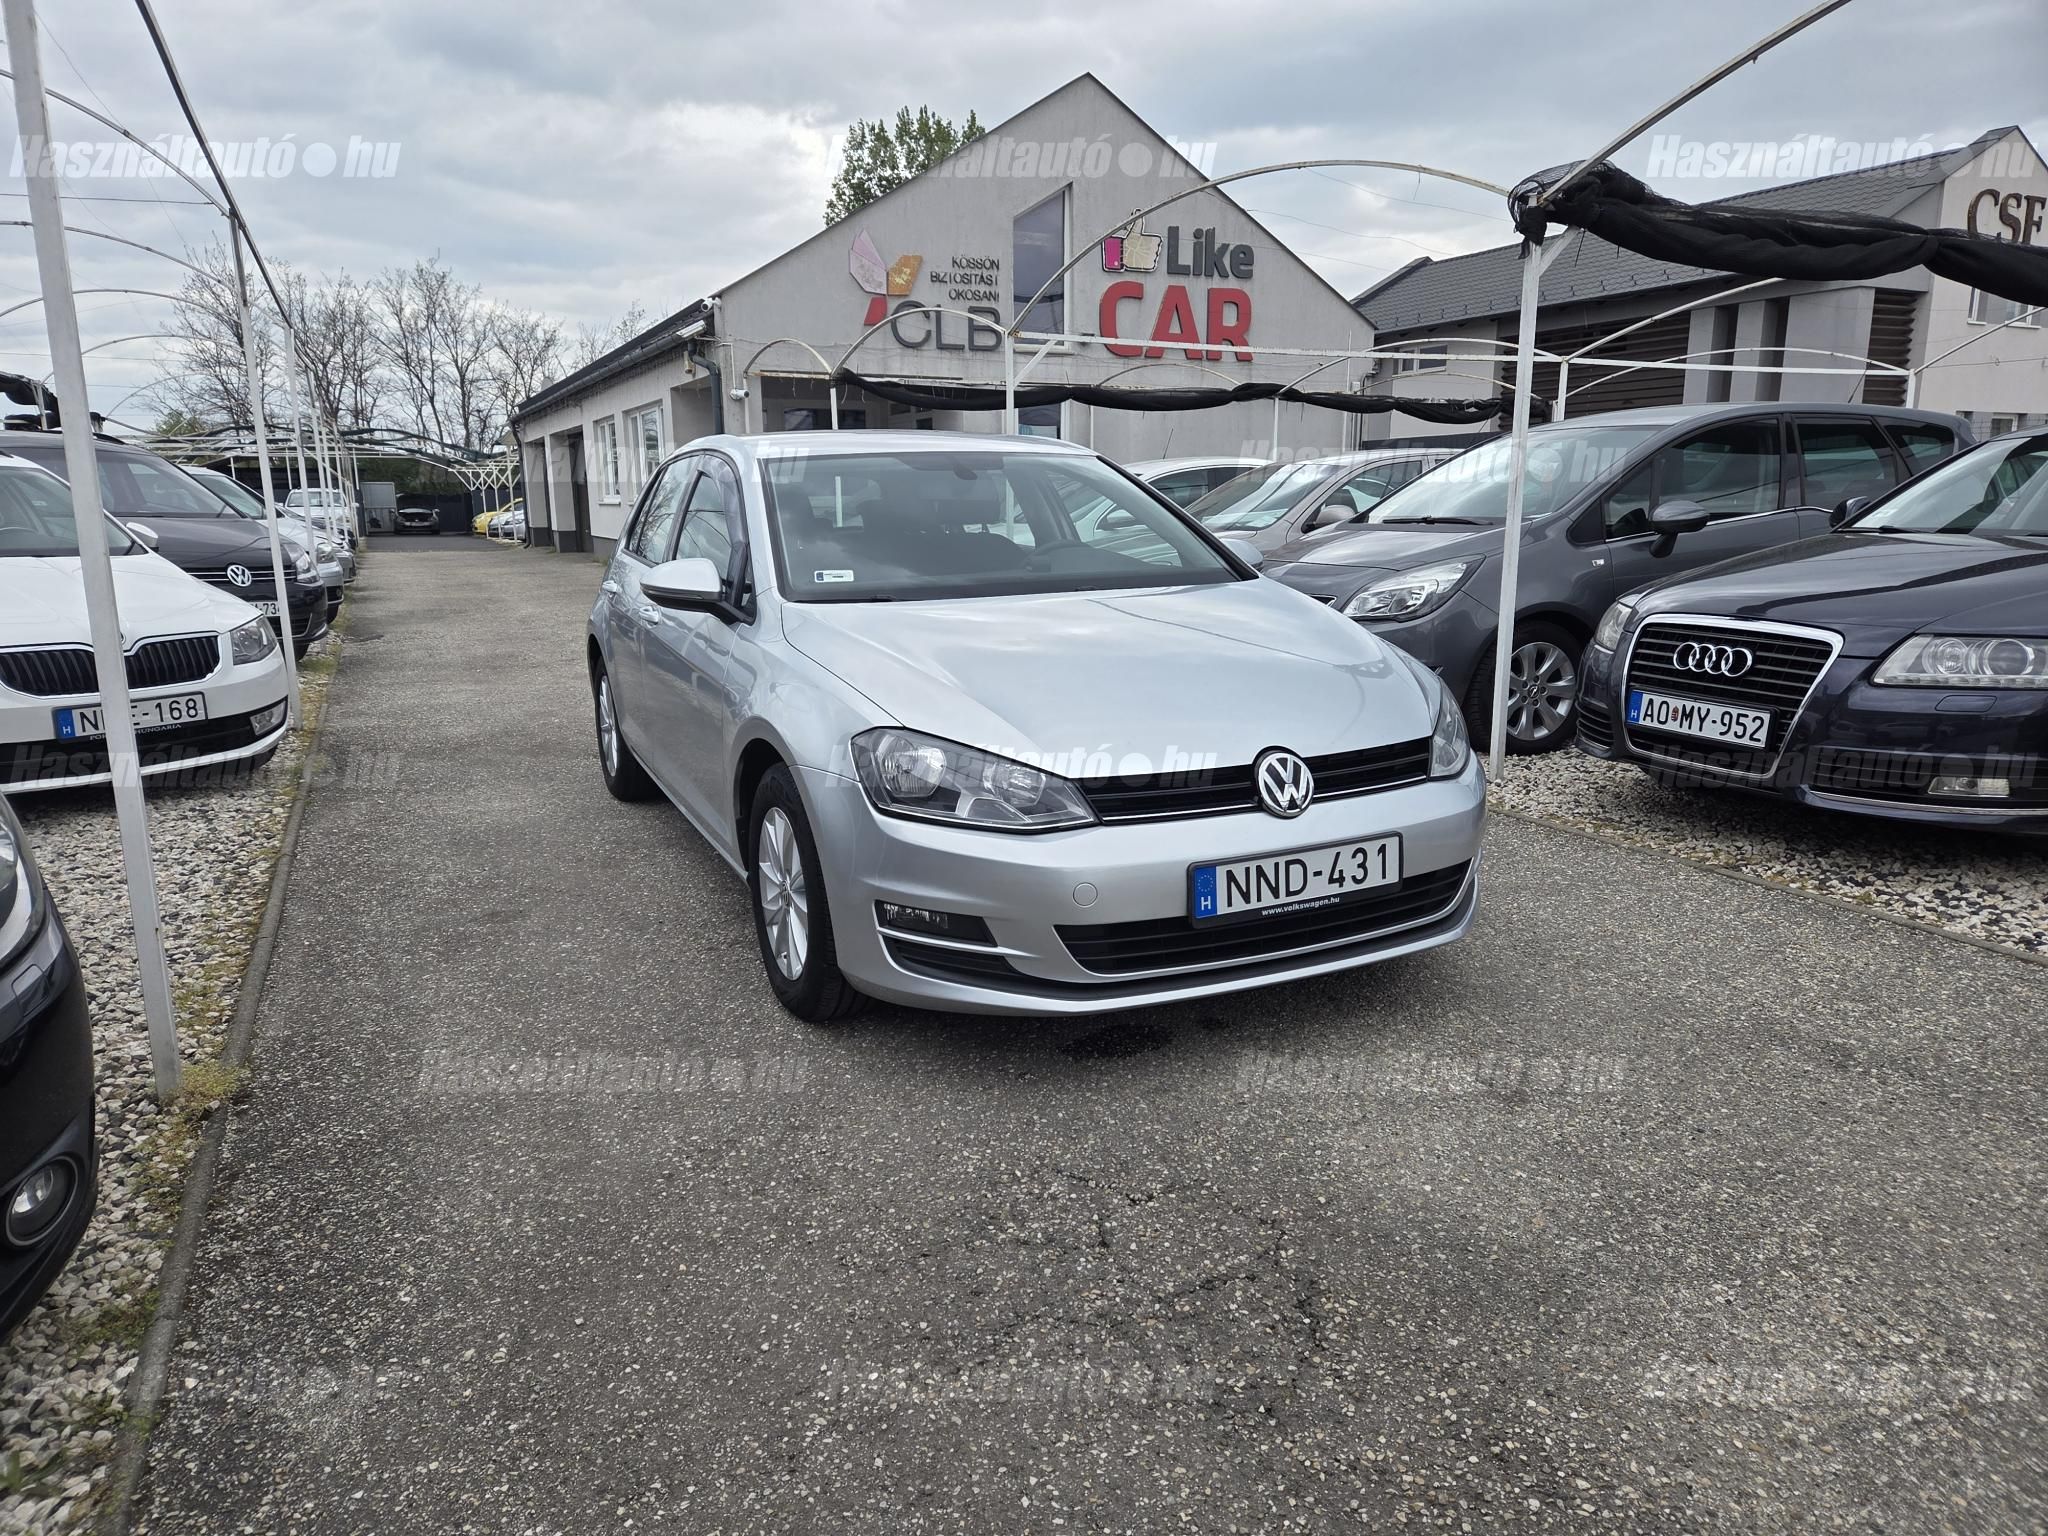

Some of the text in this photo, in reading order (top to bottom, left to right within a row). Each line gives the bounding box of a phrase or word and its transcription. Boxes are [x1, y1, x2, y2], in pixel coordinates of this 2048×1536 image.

[952, 254, 1000, 273] KÖSSÖN
[1167, 225, 1255, 279] Like
[890, 299, 1003, 351] CLB
[1099, 280, 1254, 362] CAR
[79, 698, 199, 732] NE-168
[1200, 843, 1387, 911] H NND-431
[1261, 896, 1340, 916] www.volkswagen.hu
